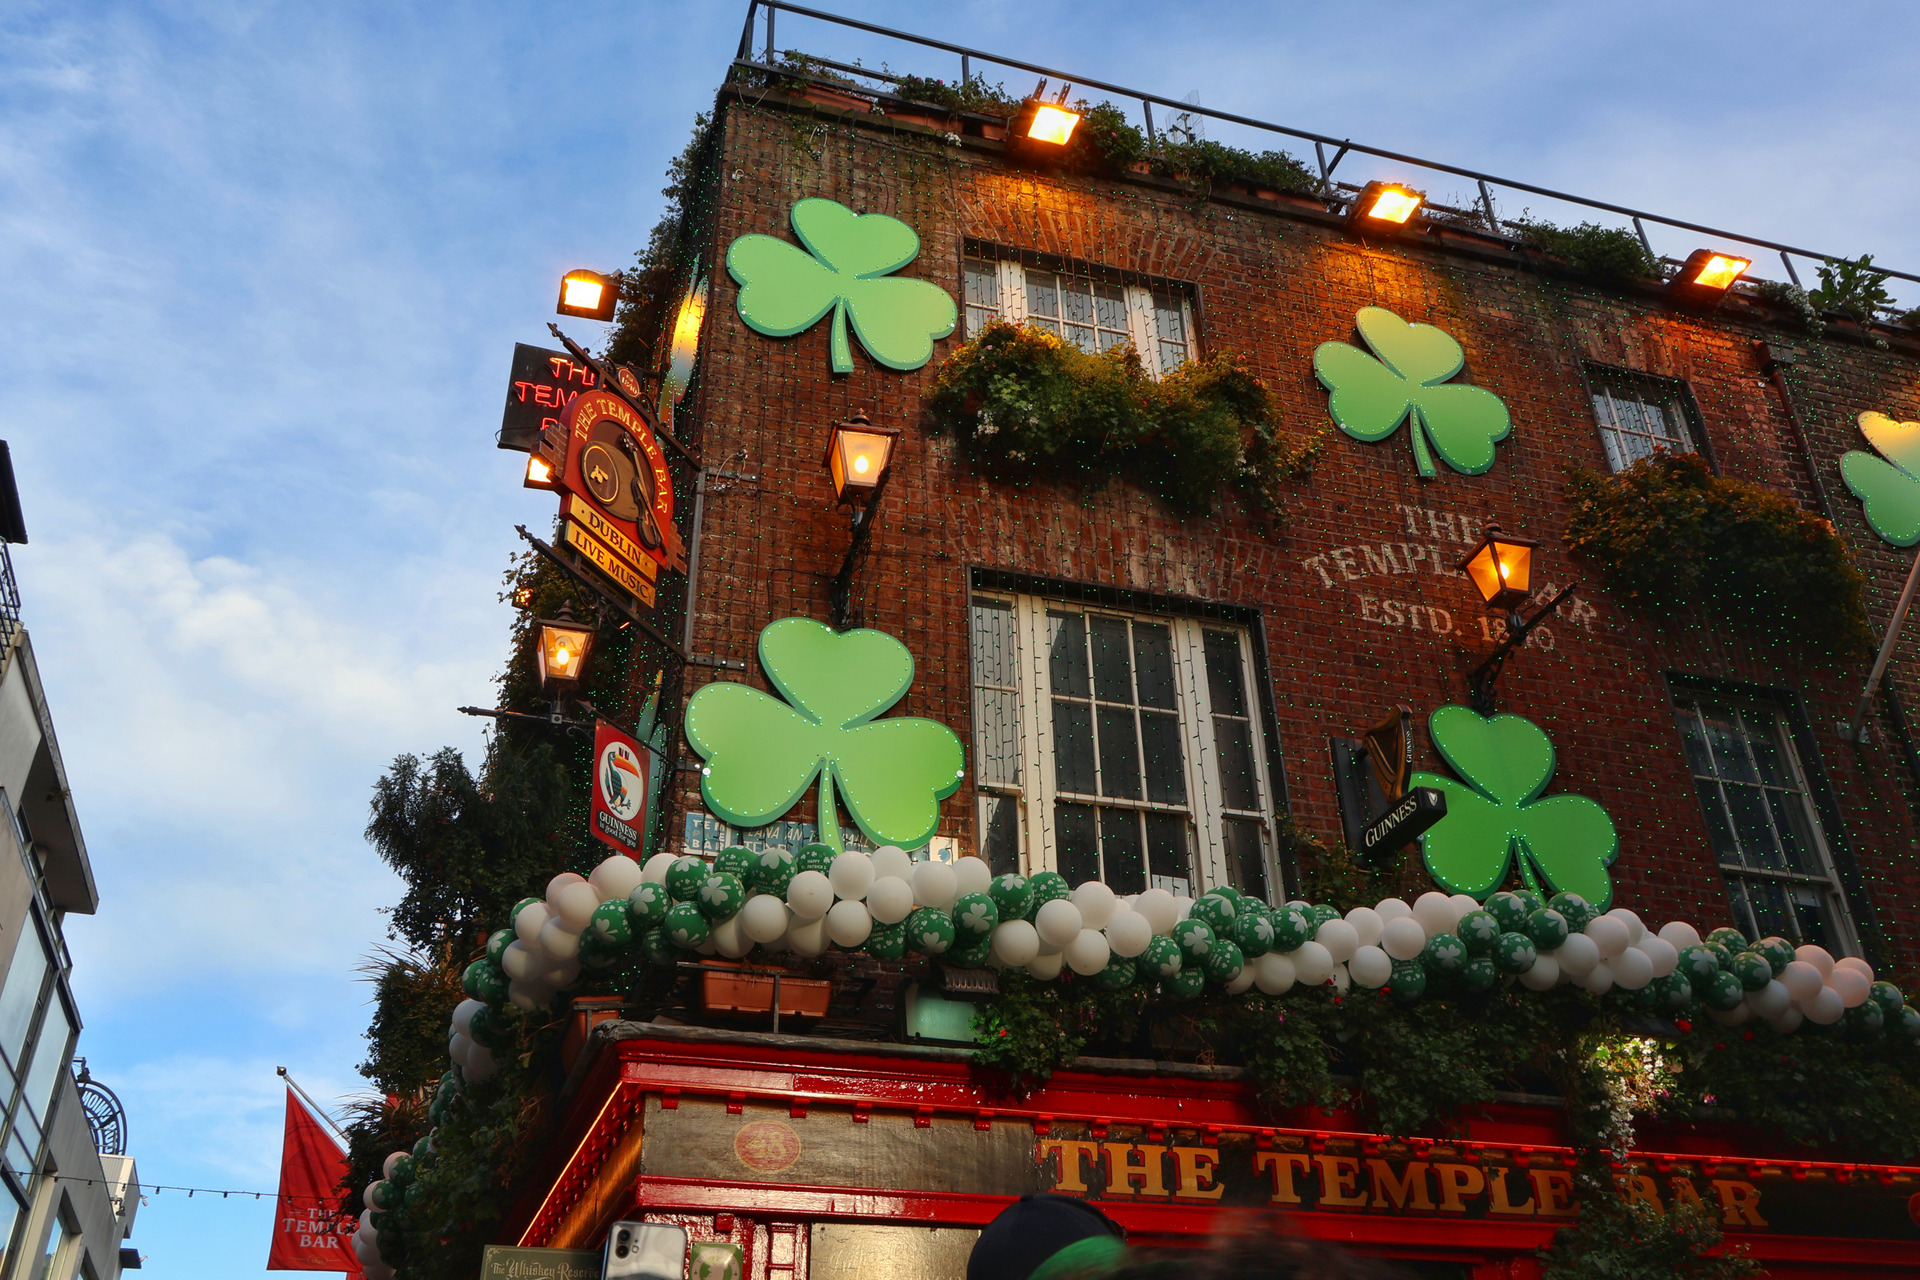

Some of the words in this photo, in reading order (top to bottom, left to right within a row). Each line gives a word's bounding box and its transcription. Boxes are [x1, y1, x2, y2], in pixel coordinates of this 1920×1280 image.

[575, 402, 598, 441] THE
[597, 399, 657, 460] TEMPLE
[655, 466, 669, 514] BAR
[588, 511, 642, 565] DUBLIN
[574, 530, 606, 566] LIVE
[608, 558, 649, 599] MUSIC
[1532, 582, 1598, 634] AR
[599, 811, 638, 841] GUINNESS
[604, 825, 618, 837] good
[618, 831, 627, 842] for
[1364, 796, 1418, 848] GUINNESS
[1037, 1138, 1225, 1202] THE
[1253, 1151, 1580, 1217] TEMPLE
[307, 1207, 337, 1220] THE
[300, 1234, 339, 1249] BAR
[491, 1262, 505, 1275] The
[506, 1258, 556, 1280] Whiskey
[557, 1262, 600, 1280] Reserve
